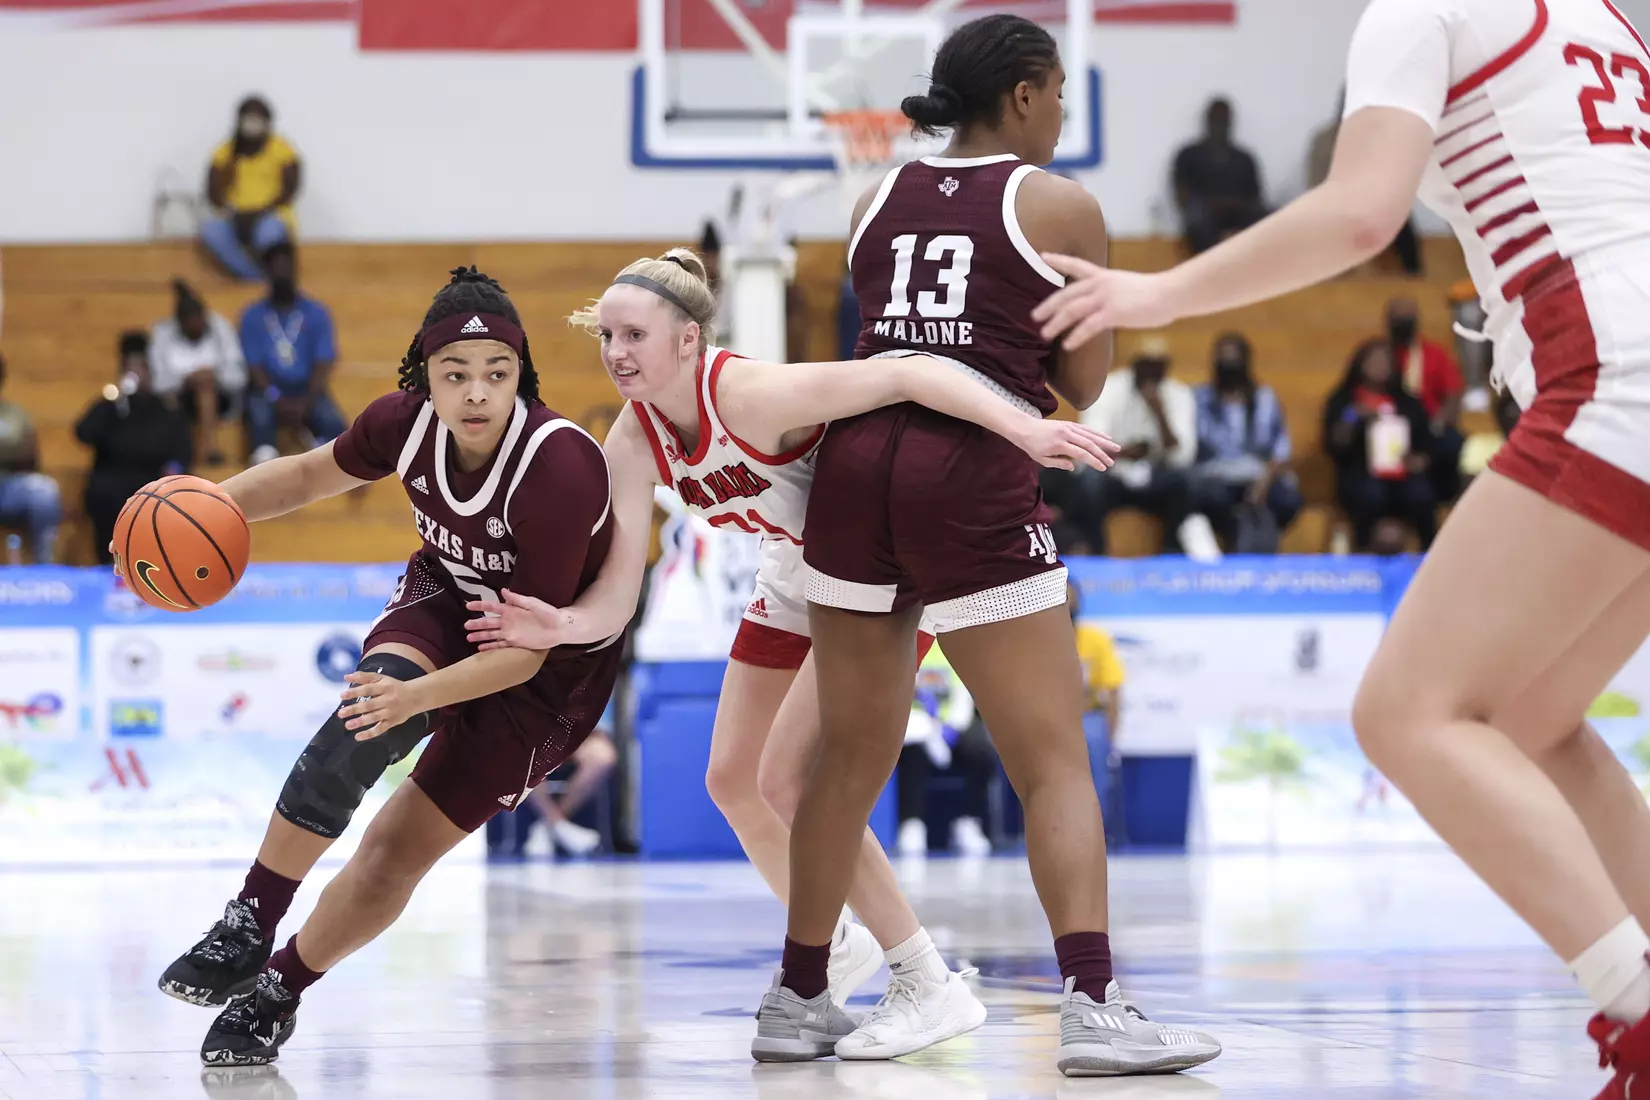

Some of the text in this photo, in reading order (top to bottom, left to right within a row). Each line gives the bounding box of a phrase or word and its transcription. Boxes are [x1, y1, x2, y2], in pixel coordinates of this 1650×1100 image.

[1563, 42, 1650, 150] 23
[883, 234, 974, 318] 13
[460, 325, 489, 334] adidas
[874, 319, 973, 346] MALONE
[411, 501, 463, 560] EXAS
